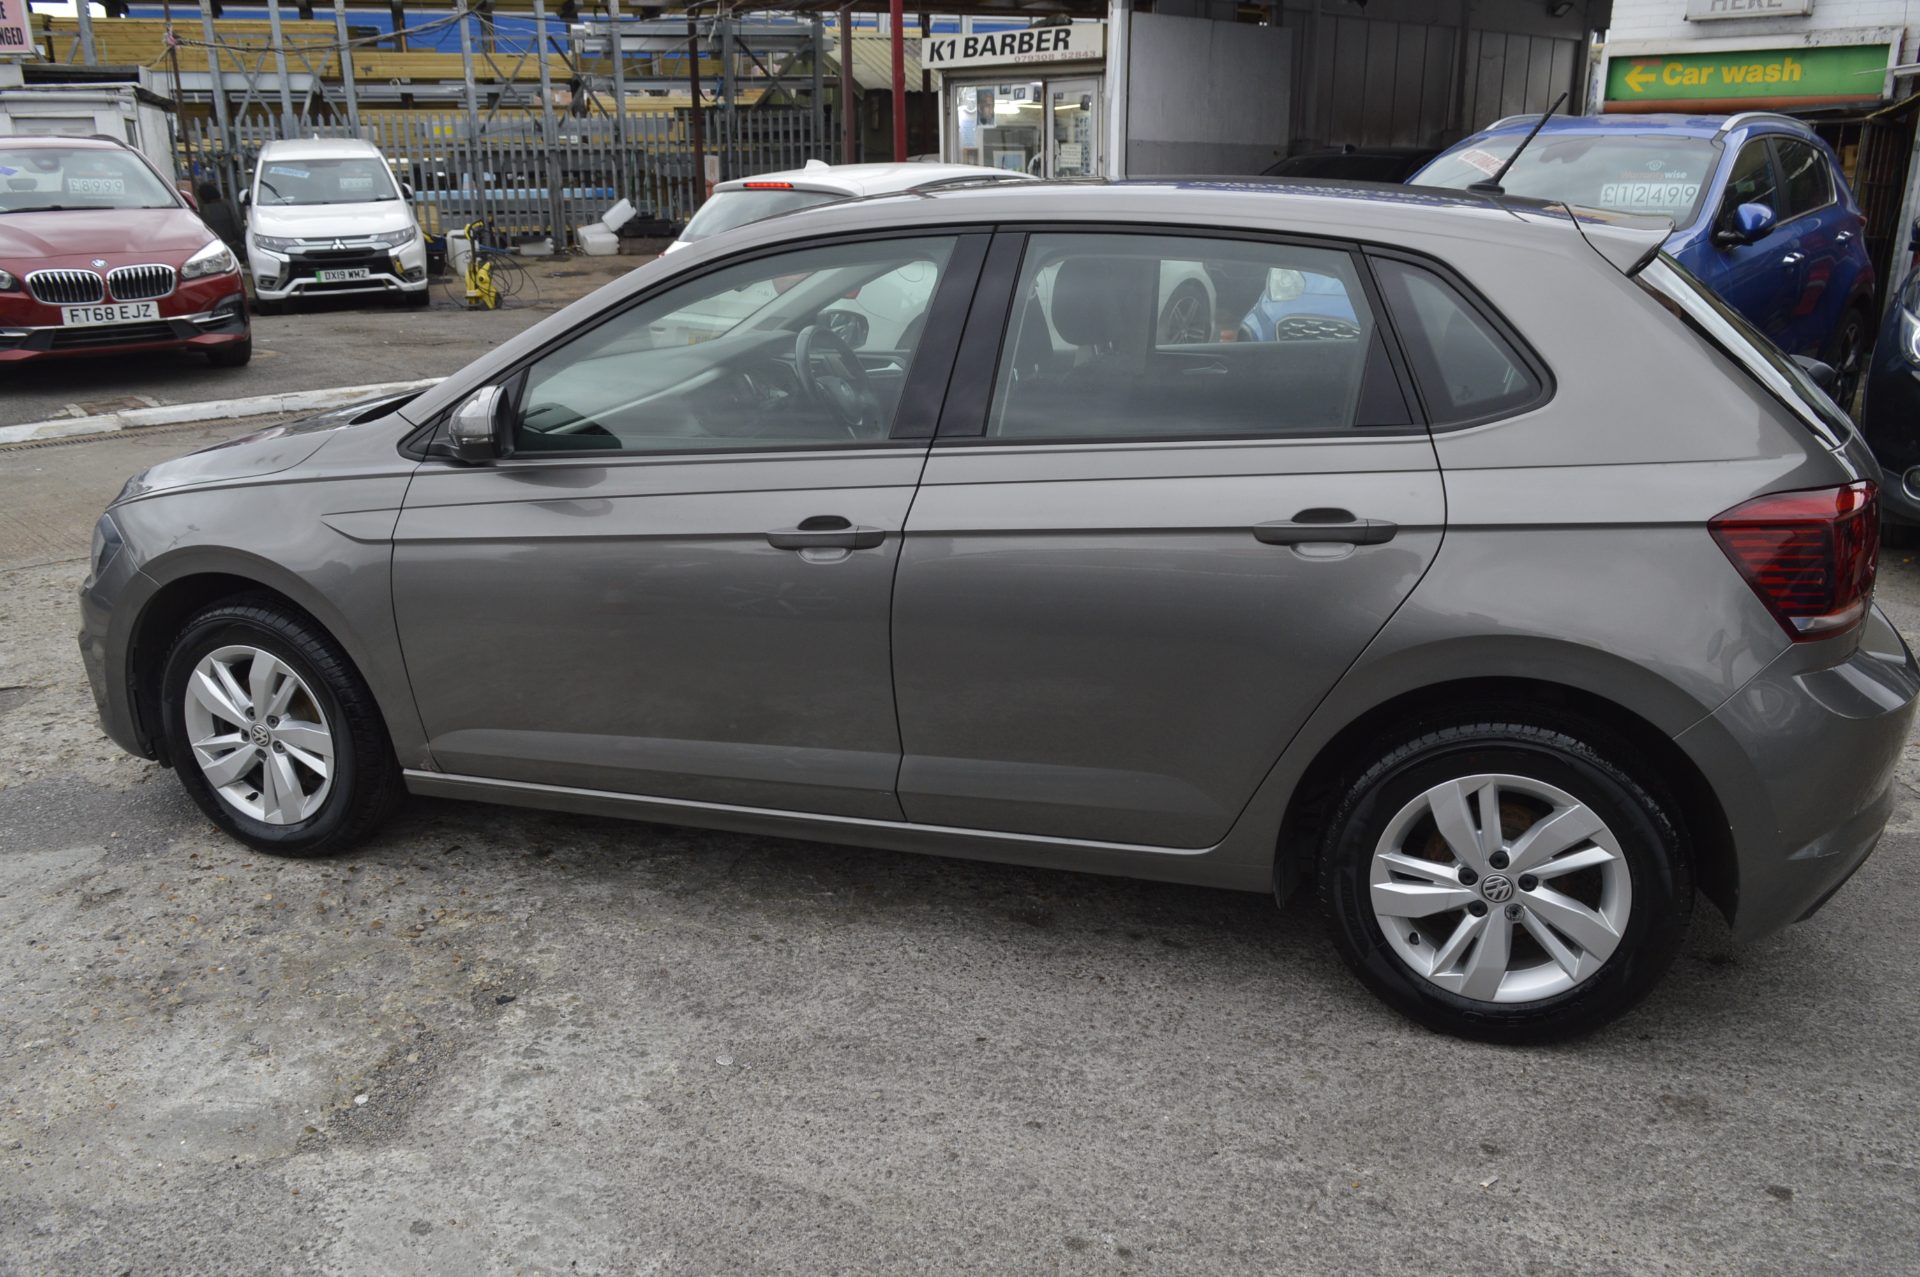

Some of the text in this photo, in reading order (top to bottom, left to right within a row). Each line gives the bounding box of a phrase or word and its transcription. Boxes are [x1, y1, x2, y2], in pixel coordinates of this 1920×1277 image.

[929, 28, 1072, 63] K1 BARBER
[1662, 56, 1802, 87] Car wash
[1602, 185, 1698, 204] £12499
[69, 303, 152, 323] FT68 EJZ
